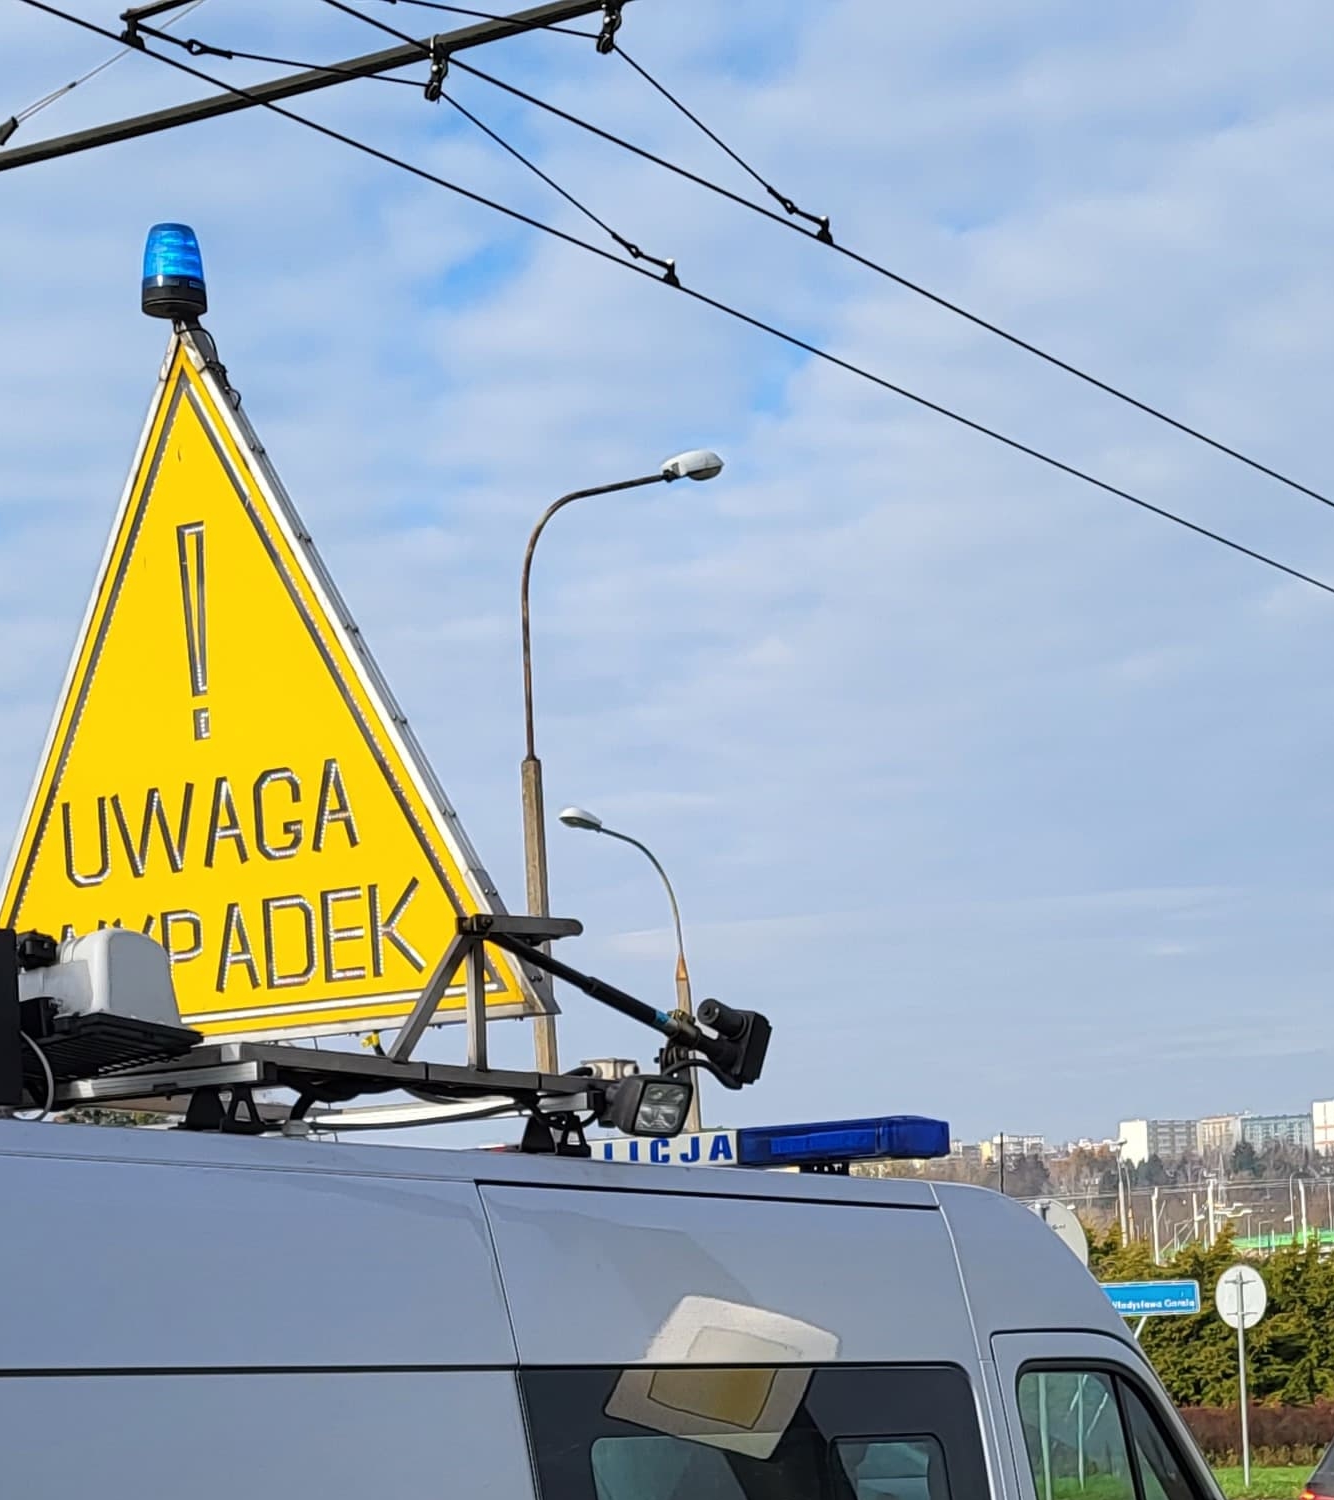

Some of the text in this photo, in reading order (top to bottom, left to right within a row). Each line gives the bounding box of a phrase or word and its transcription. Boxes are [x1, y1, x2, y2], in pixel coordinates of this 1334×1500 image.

[62, 758, 360, 888] UWAGA
[61, 877, 428, 995] PADEK
[603, 1134, 733, 1164] LICJA
